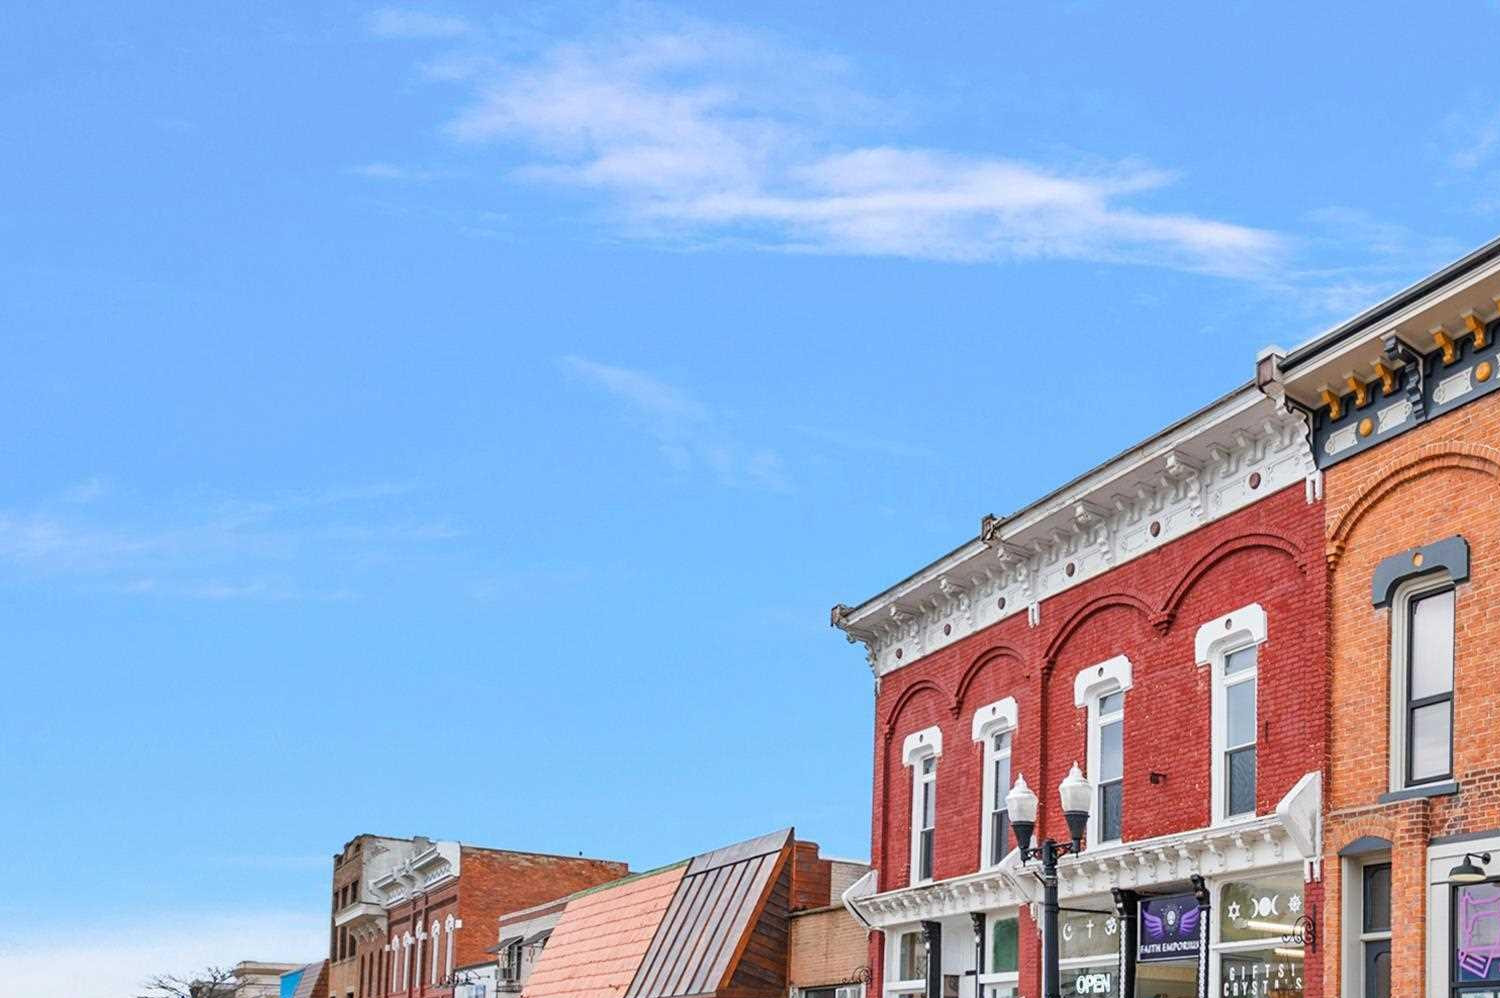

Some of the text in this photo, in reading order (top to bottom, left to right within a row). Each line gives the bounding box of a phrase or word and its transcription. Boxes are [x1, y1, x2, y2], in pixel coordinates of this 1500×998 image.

[1140, 940, 1199, 953] FAITH EMPORIUM
[1075, 973, 1111, 994] OPEN
